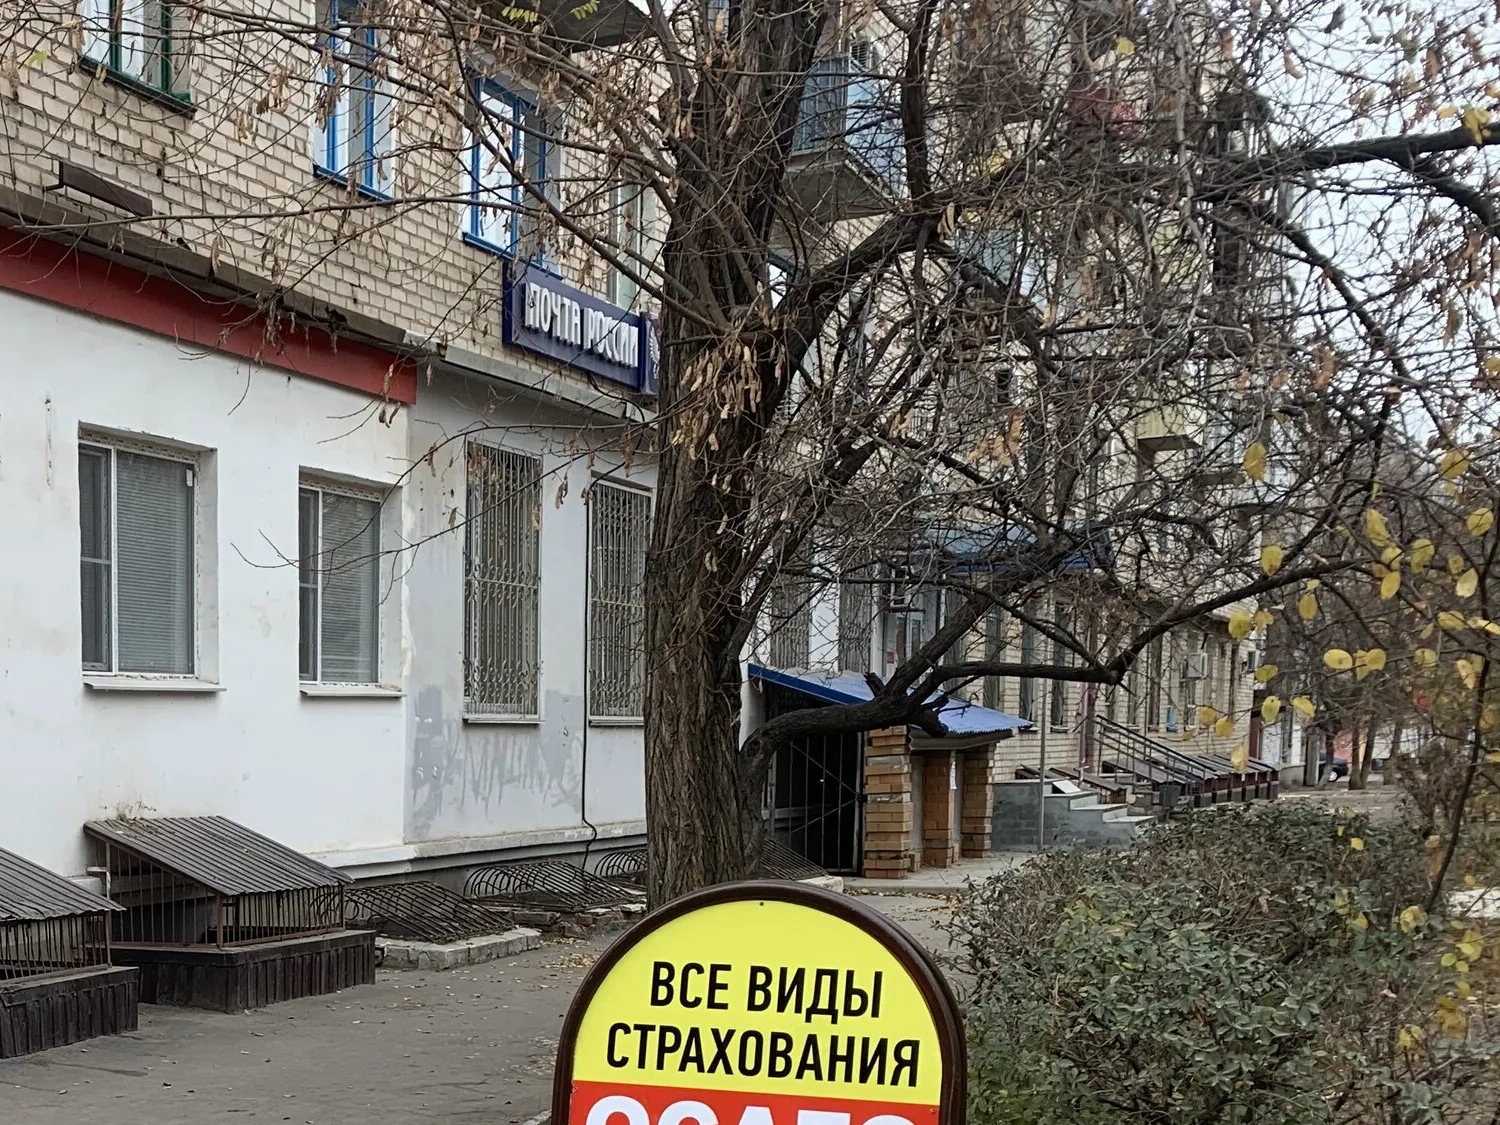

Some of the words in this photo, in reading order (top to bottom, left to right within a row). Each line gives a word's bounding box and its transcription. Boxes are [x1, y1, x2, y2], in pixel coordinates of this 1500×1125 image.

[524, 282, 581, 345] ПОЧТА
[583, 307, 639, 368] РОССИИ
[650, 960, 732, 1011] ВСЕ
[746, 965, 883, 1024] ВИДЫ
[606, 1022, 921, 1088] СТРАХОВАНИЯ
